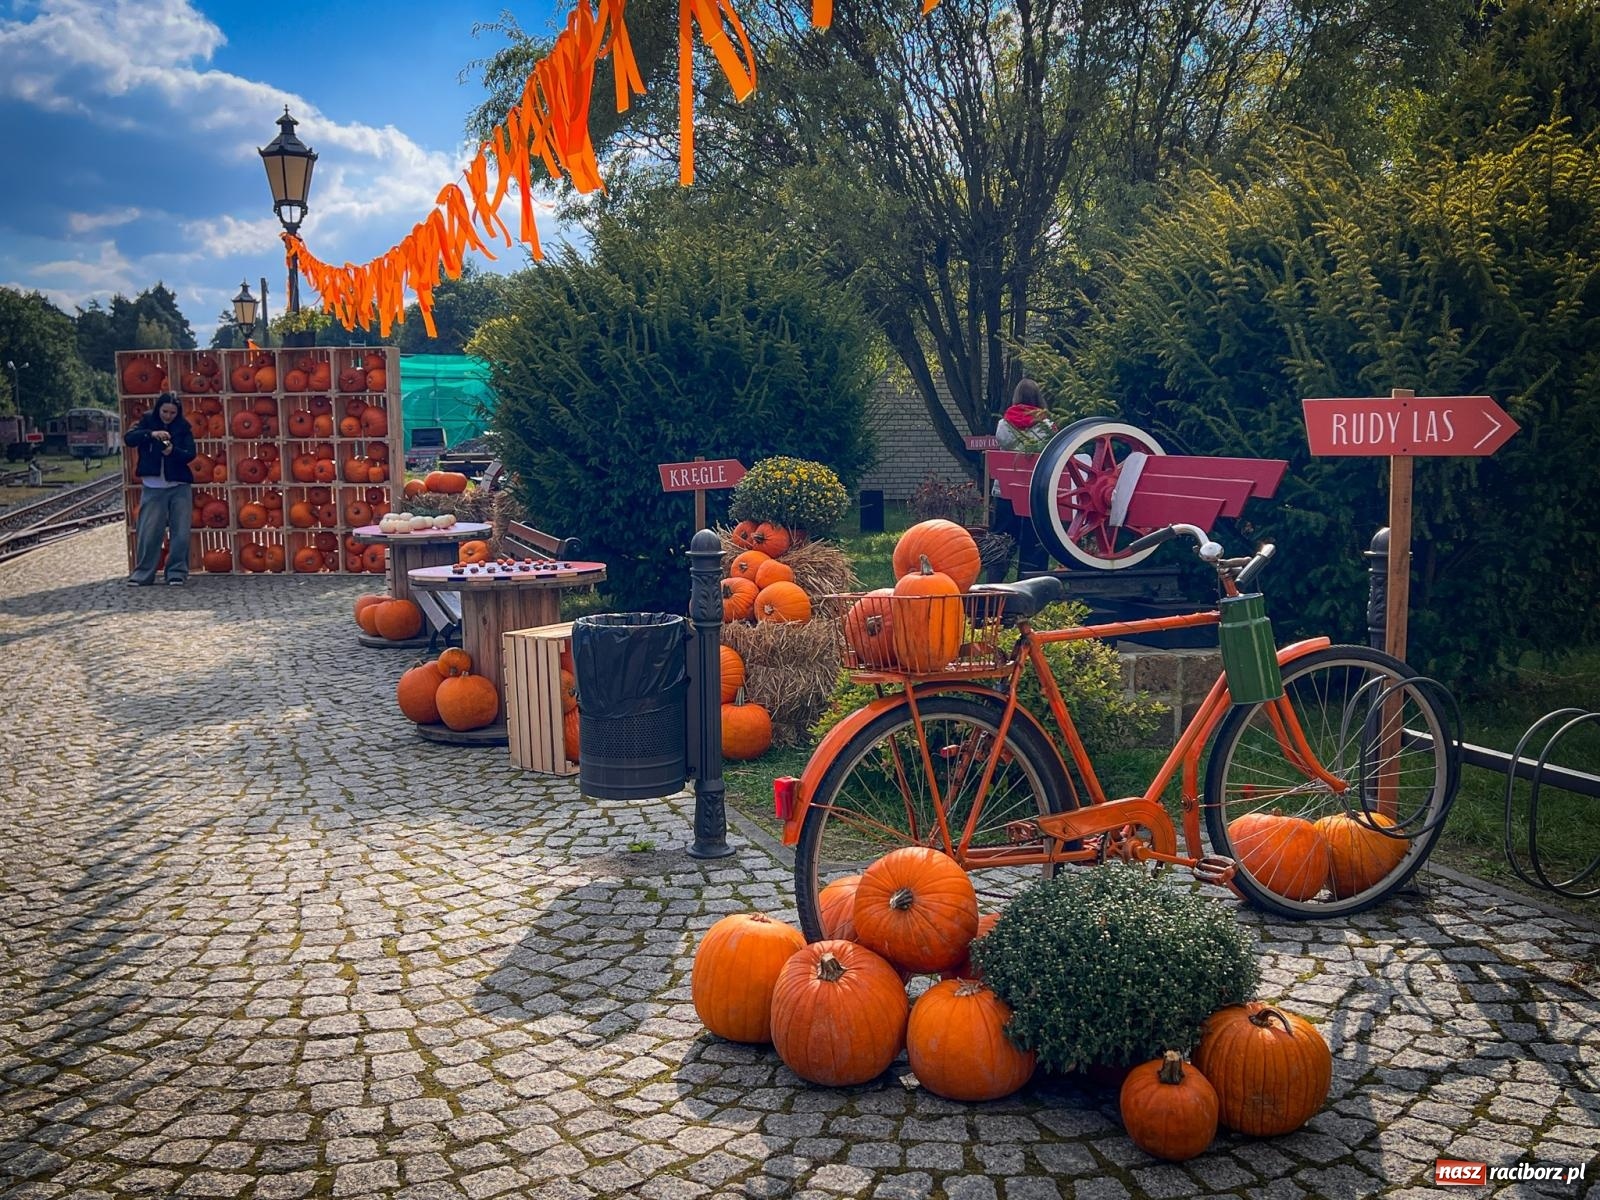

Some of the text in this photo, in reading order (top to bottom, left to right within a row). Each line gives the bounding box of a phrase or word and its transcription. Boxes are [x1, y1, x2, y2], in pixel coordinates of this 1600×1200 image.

[1332, 410, 1454, 445] RUDY LAS
[670, 465, 727, 487] KRĘGLE
